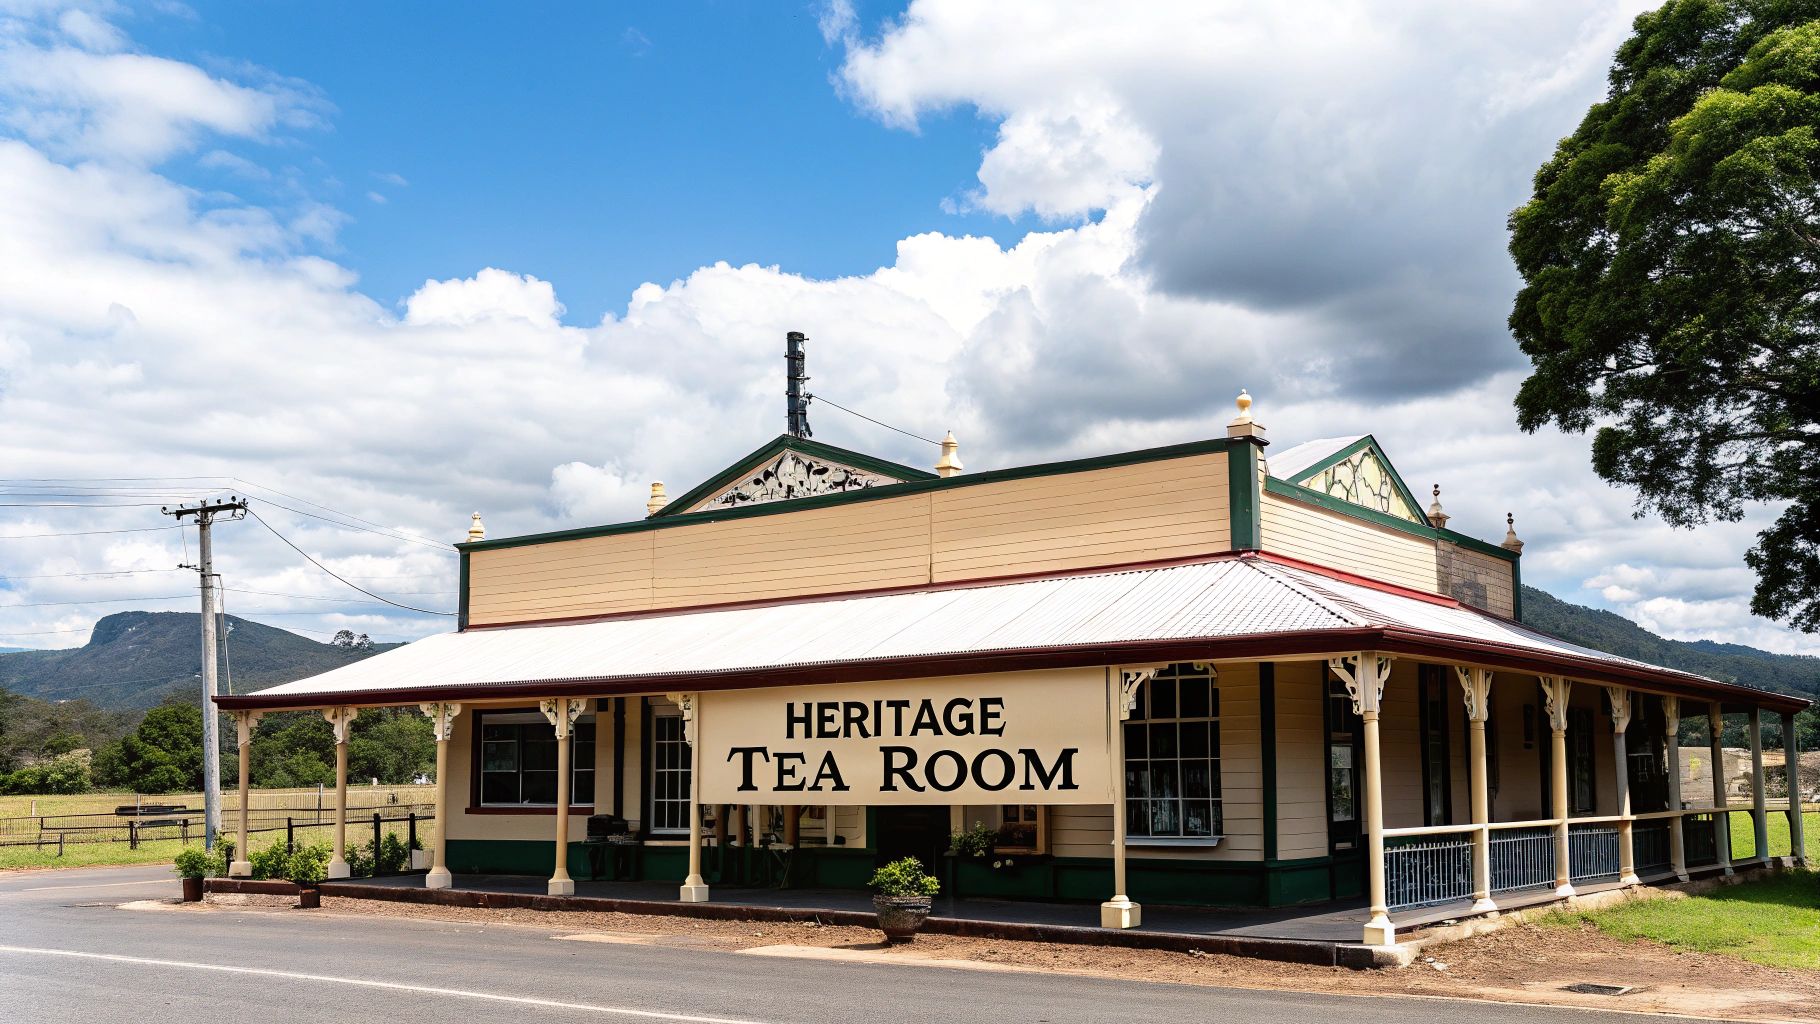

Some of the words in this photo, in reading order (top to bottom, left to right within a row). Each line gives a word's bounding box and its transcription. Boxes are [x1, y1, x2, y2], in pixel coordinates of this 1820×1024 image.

[785, 696, 1007, 739] HERITAGE
[726, 746, 851, 793] TEA
[879, 745, 1080, 793] ROOM
